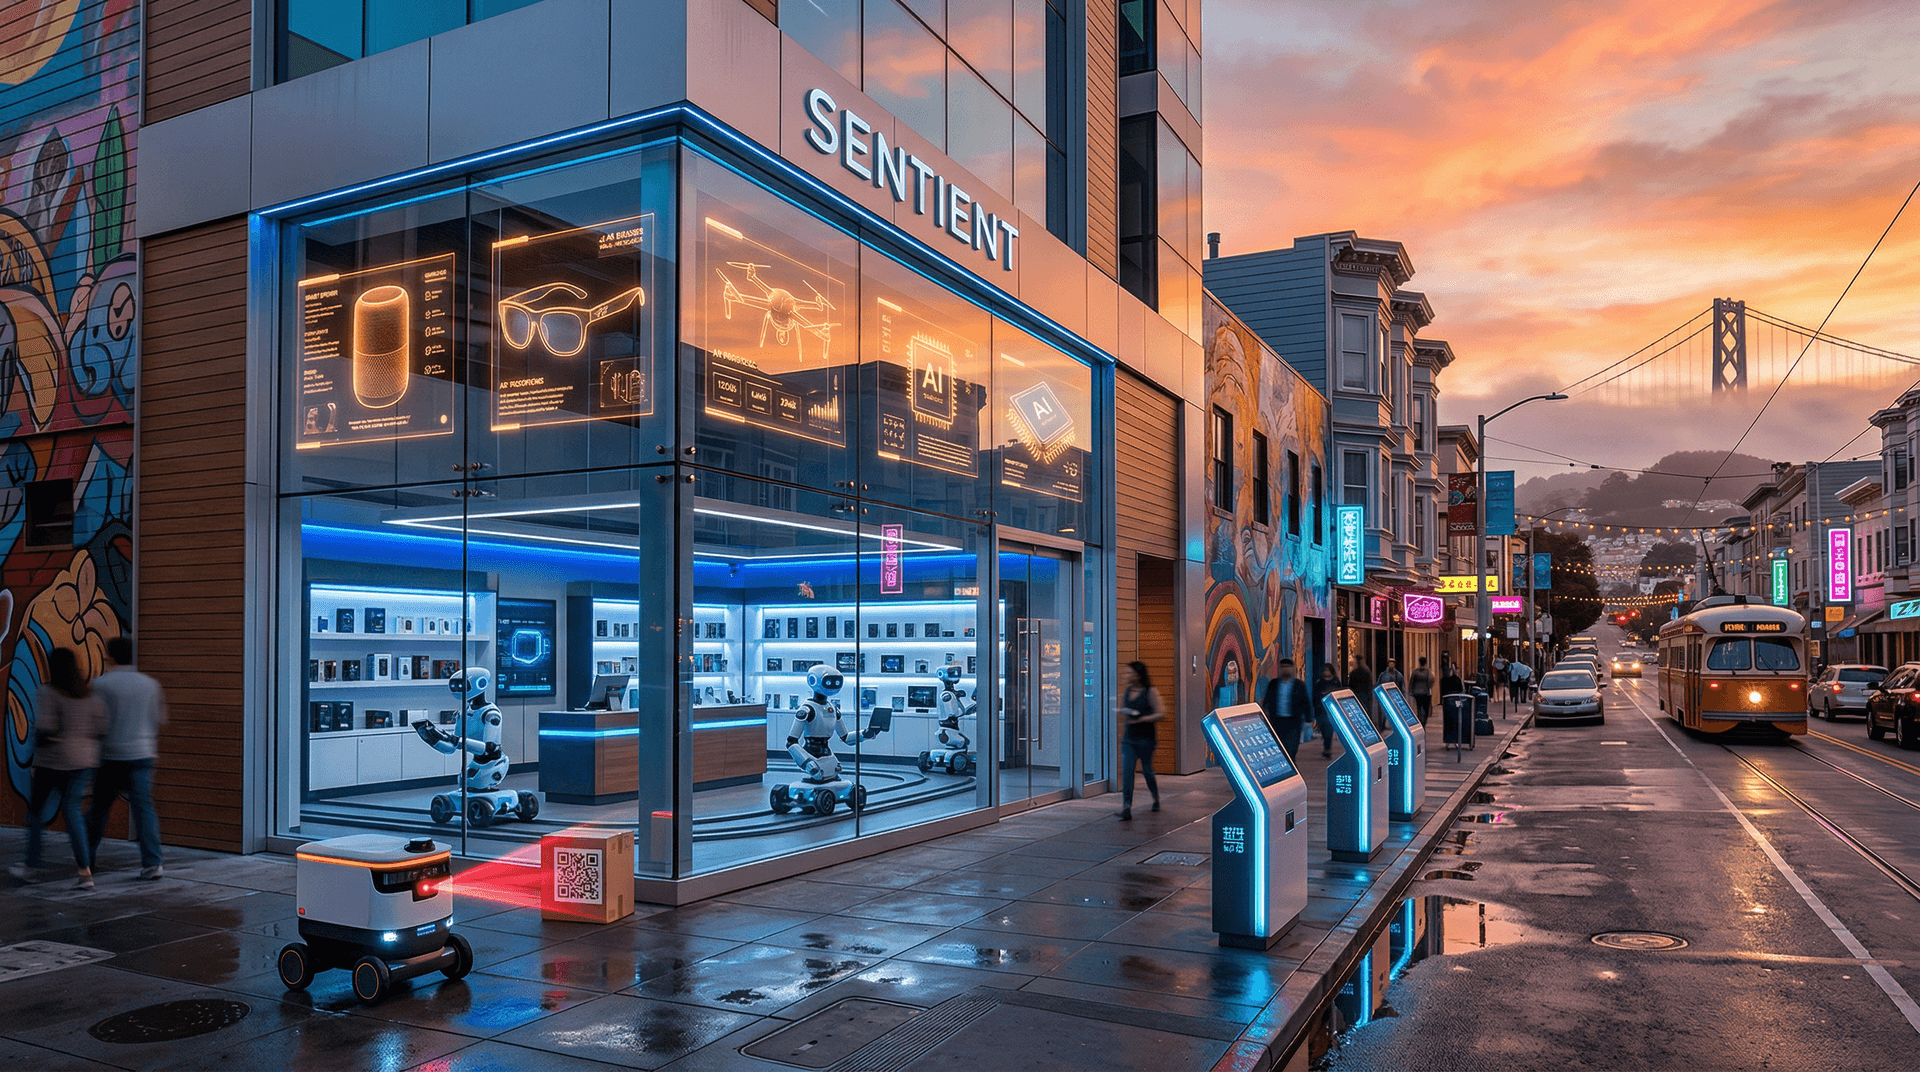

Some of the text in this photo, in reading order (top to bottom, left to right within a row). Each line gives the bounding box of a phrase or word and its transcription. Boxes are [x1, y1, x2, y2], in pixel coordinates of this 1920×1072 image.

[806, 88, 1019, 271] SENTIENT
[922, 362, 943, 394] AI
[1032, 396, 1053, 420] AI
